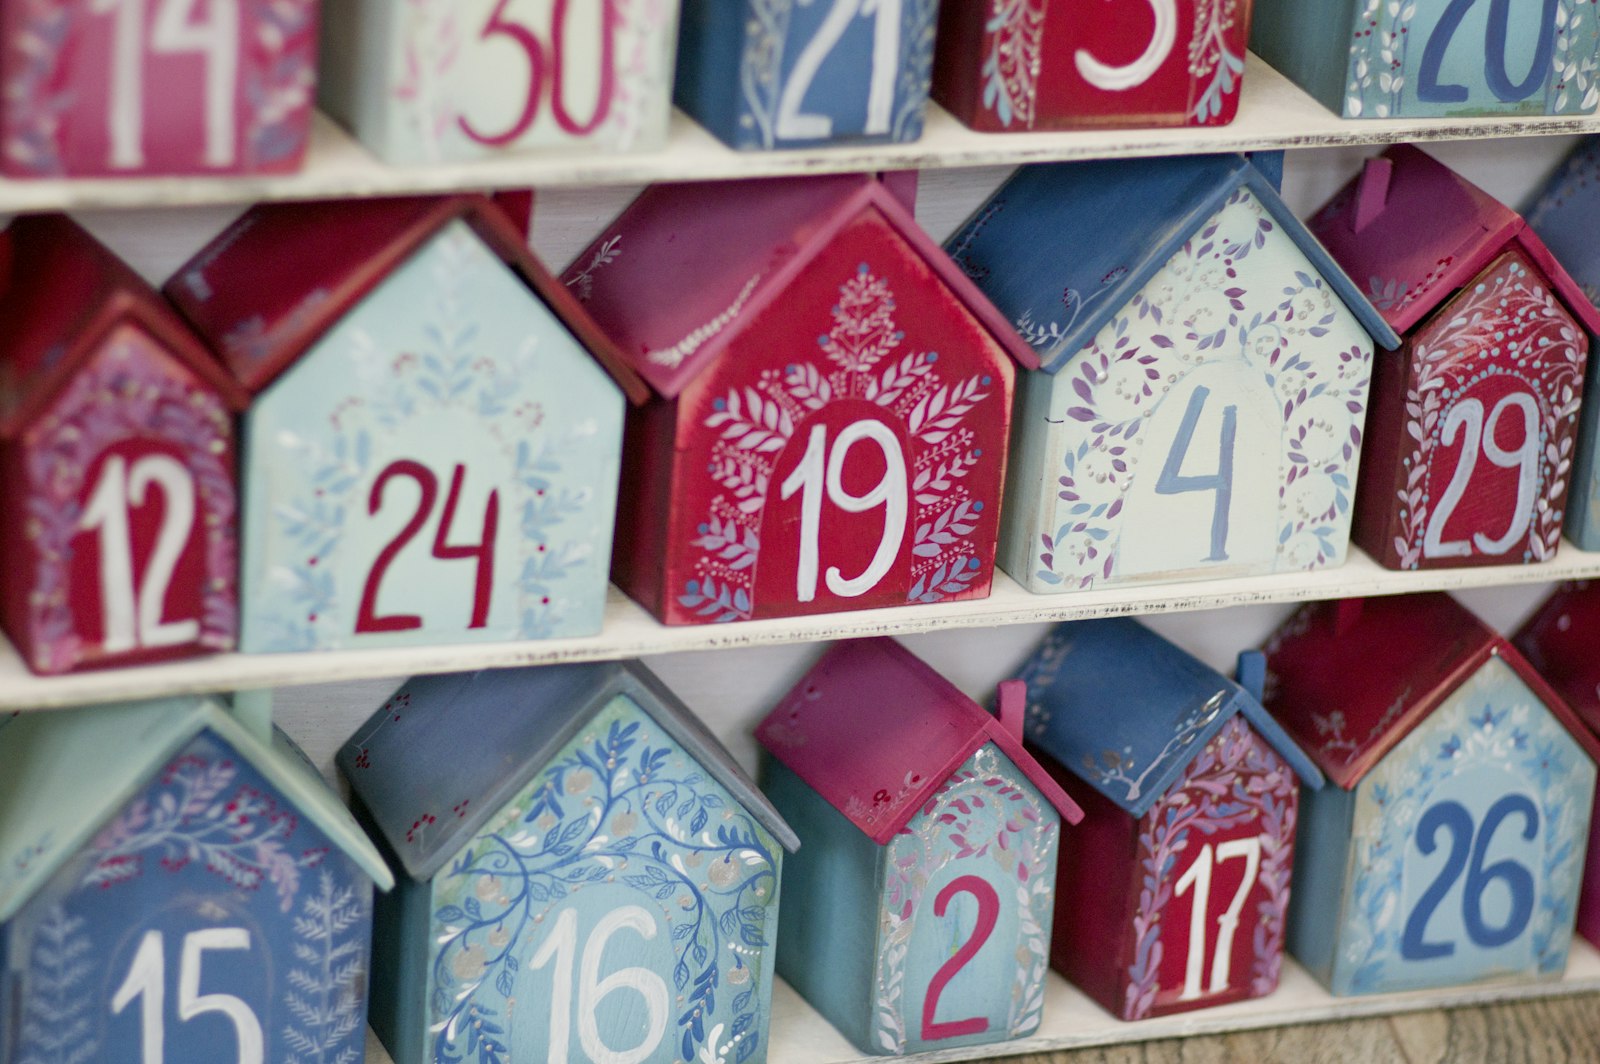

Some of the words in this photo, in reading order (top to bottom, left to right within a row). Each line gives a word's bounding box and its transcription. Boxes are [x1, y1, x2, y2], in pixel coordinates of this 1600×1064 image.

[91, 0, 238, 168] 14
[457, 0, 614, 147] 30
[776, 0, 900, 138] 21
[1417, 0, 1558, 103] 20
[80, 453, 199, 652] 12
[354, 459, 499, 634] 24
[781, 419, 908, 601] 19
[1155, 385, 1238, 561] 4
[1423, 391, 1541, 558] 29
[921, 874, 1000, 1041] 2
[1175, 836, 1262, 999] 17
[1401, 792, 1539, 961] 26
[112, 927, 263, 1064] 15
[529, 905, 669, 1064] 16
